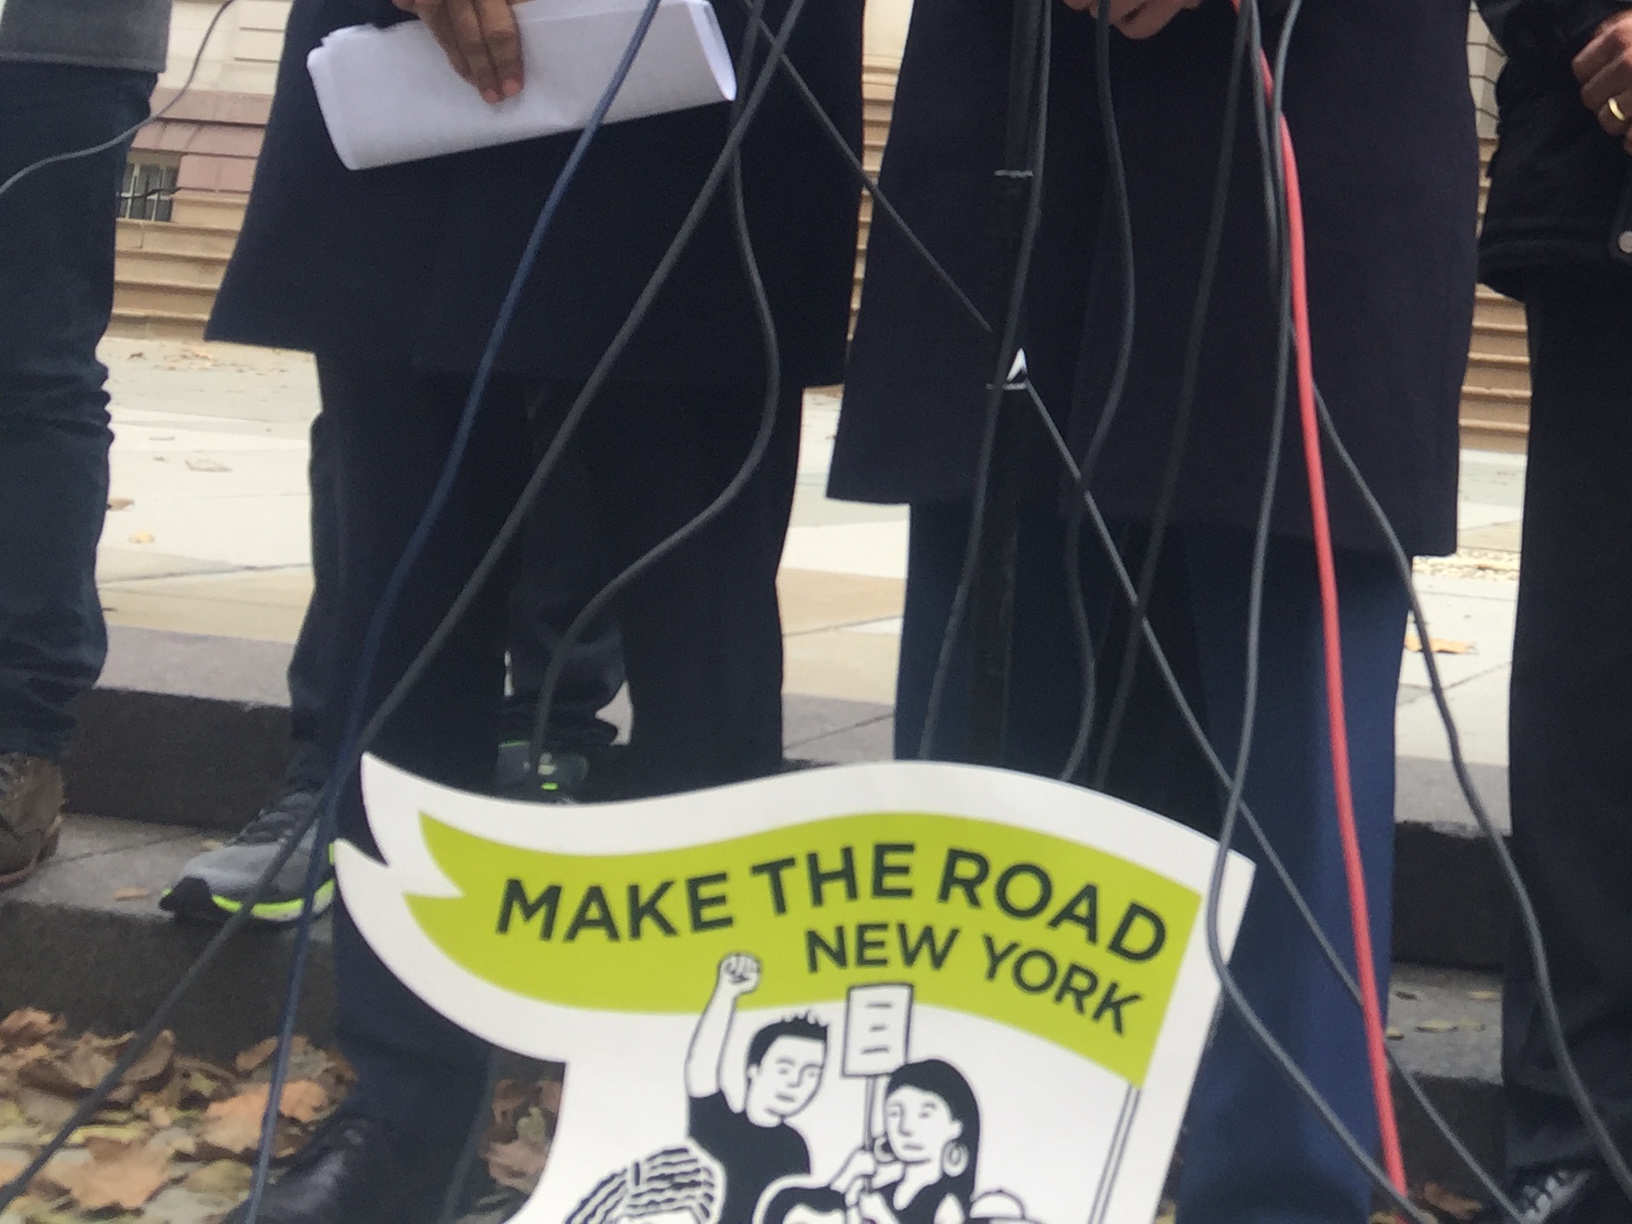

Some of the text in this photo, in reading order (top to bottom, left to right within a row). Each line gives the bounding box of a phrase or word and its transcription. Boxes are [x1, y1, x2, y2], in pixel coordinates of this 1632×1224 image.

[494, 842, 1169, 964] MAKE THE ROAD
[804, 921, 1143, 1037] NEW YORK
